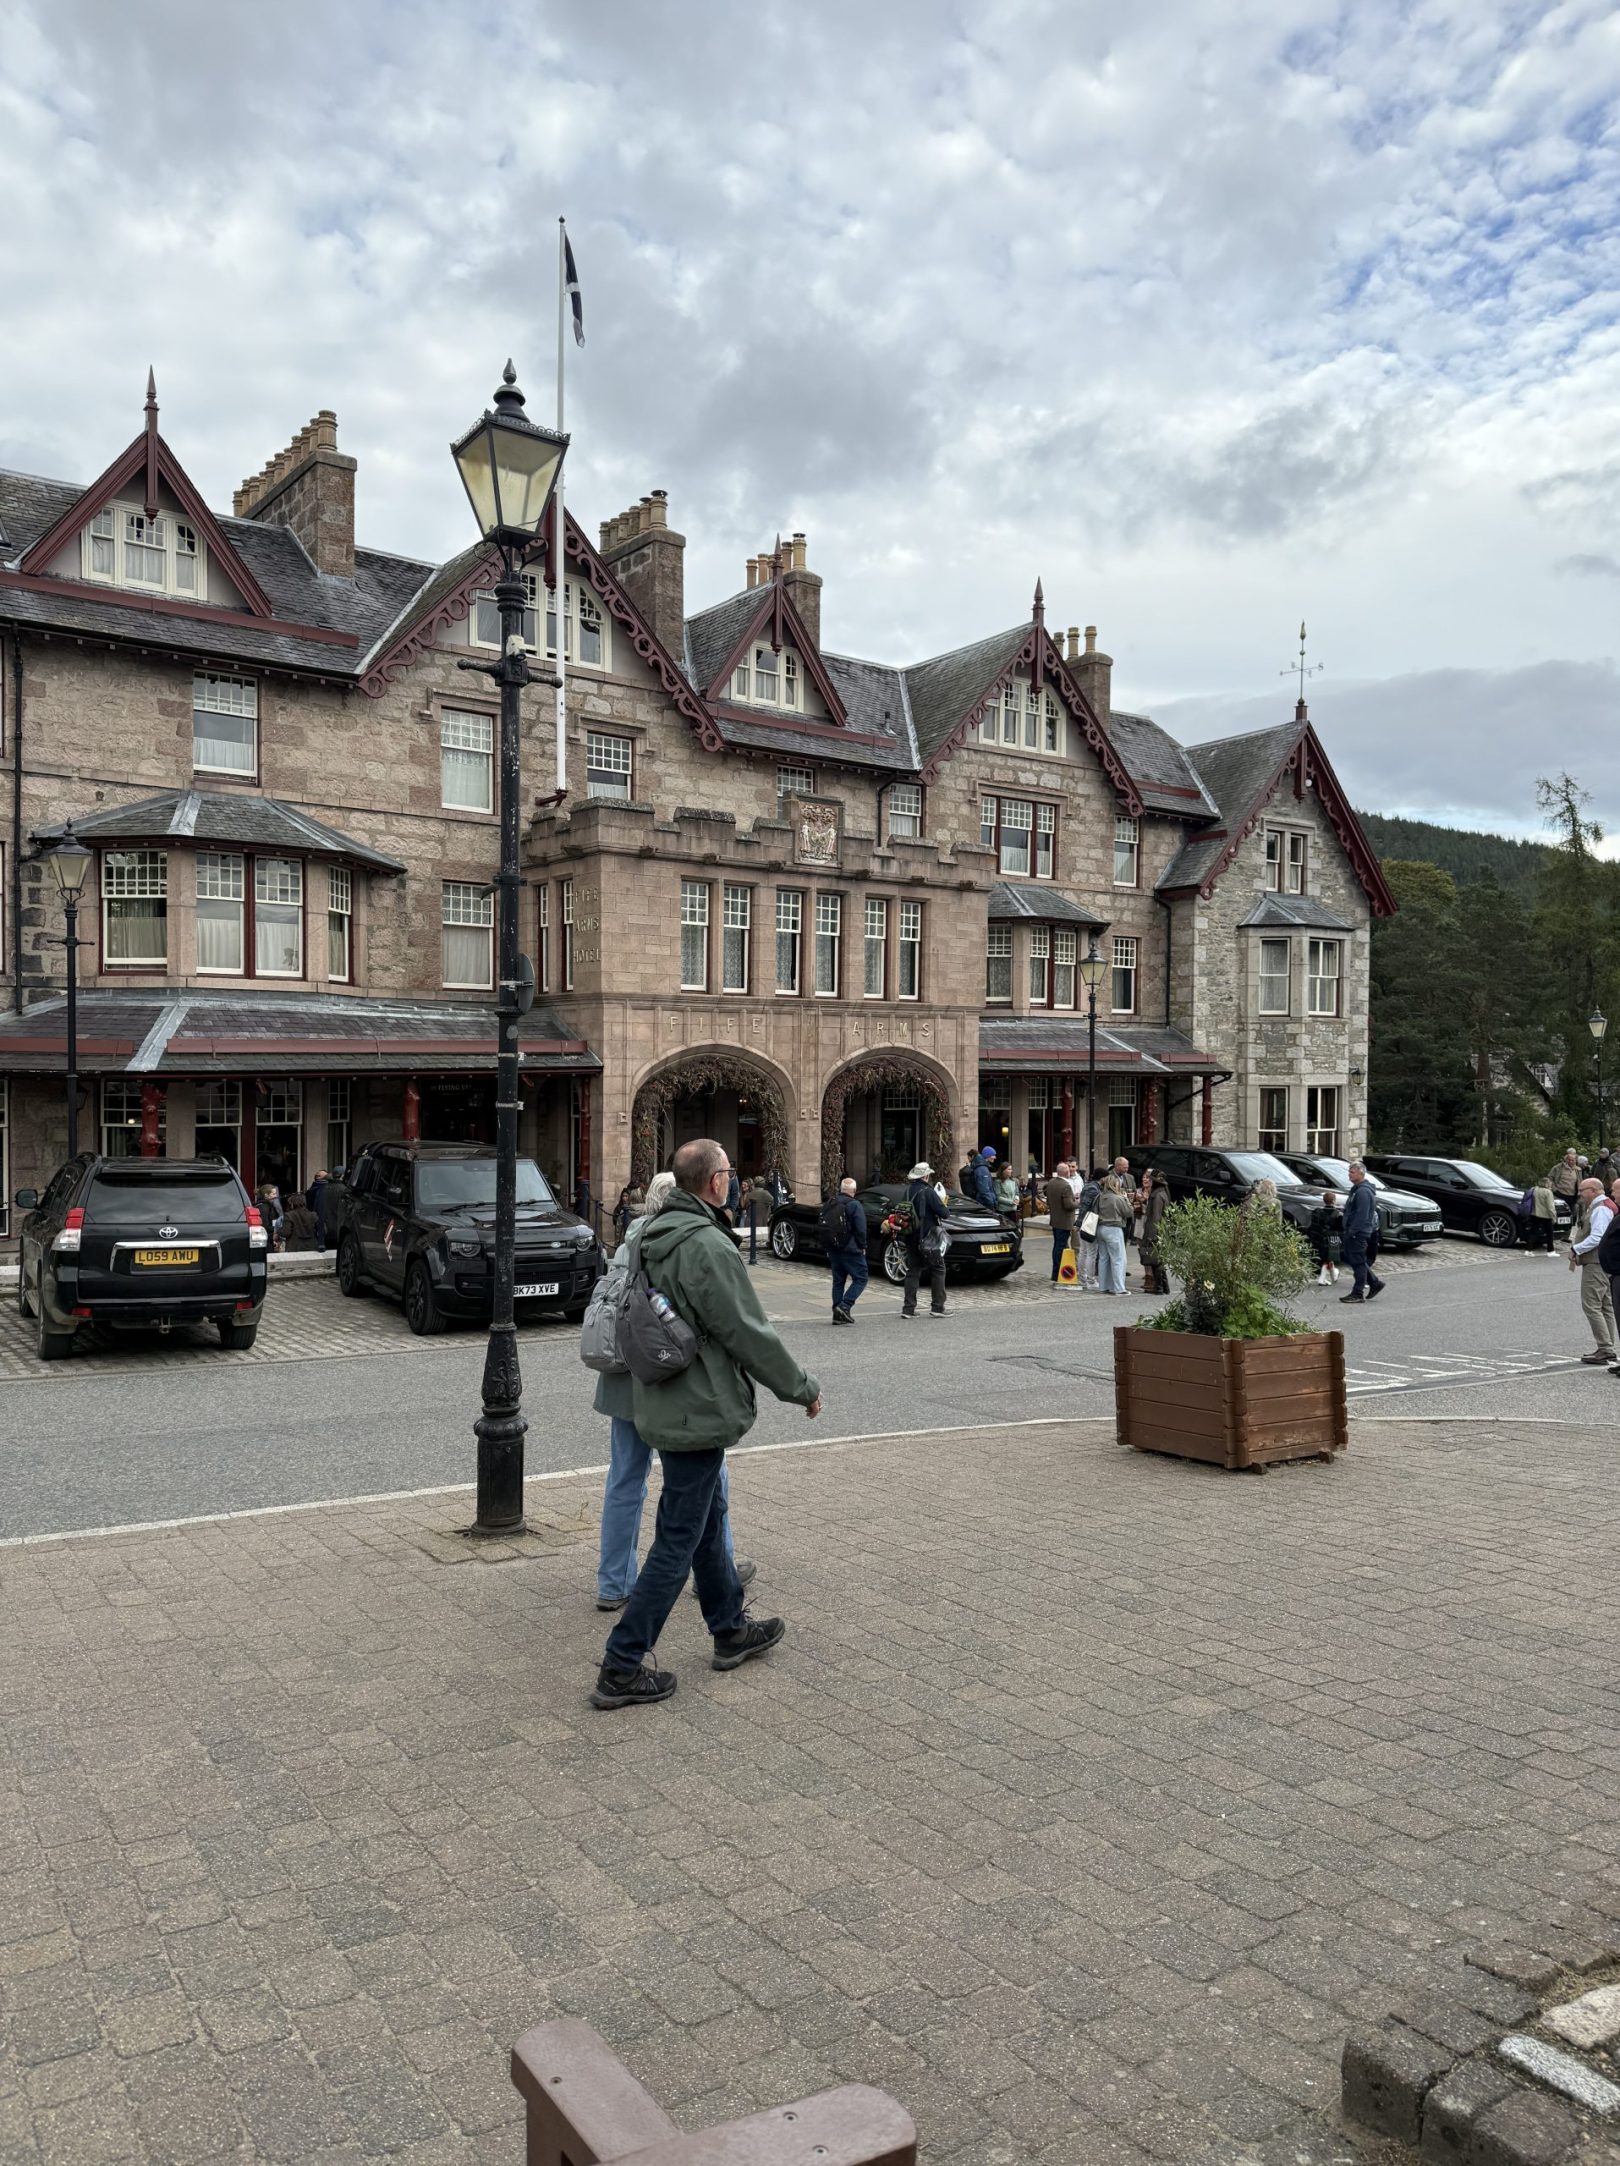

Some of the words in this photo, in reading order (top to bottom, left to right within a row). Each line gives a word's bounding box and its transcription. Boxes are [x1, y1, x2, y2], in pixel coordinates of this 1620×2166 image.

[575, 887, 599, 903] FIFE
[576, 917, 600, 932] ARMS
[573, 947, 601, 963] HOTEL
[669, 1016, 761, 1035] FIFE
[852, 1021, 930, 1038] ARMS
[172, 1250, 193, 1261] AWU
[513, 1285, 537, 1295] BK73
[538, 1284, 556, 1294] XVE
